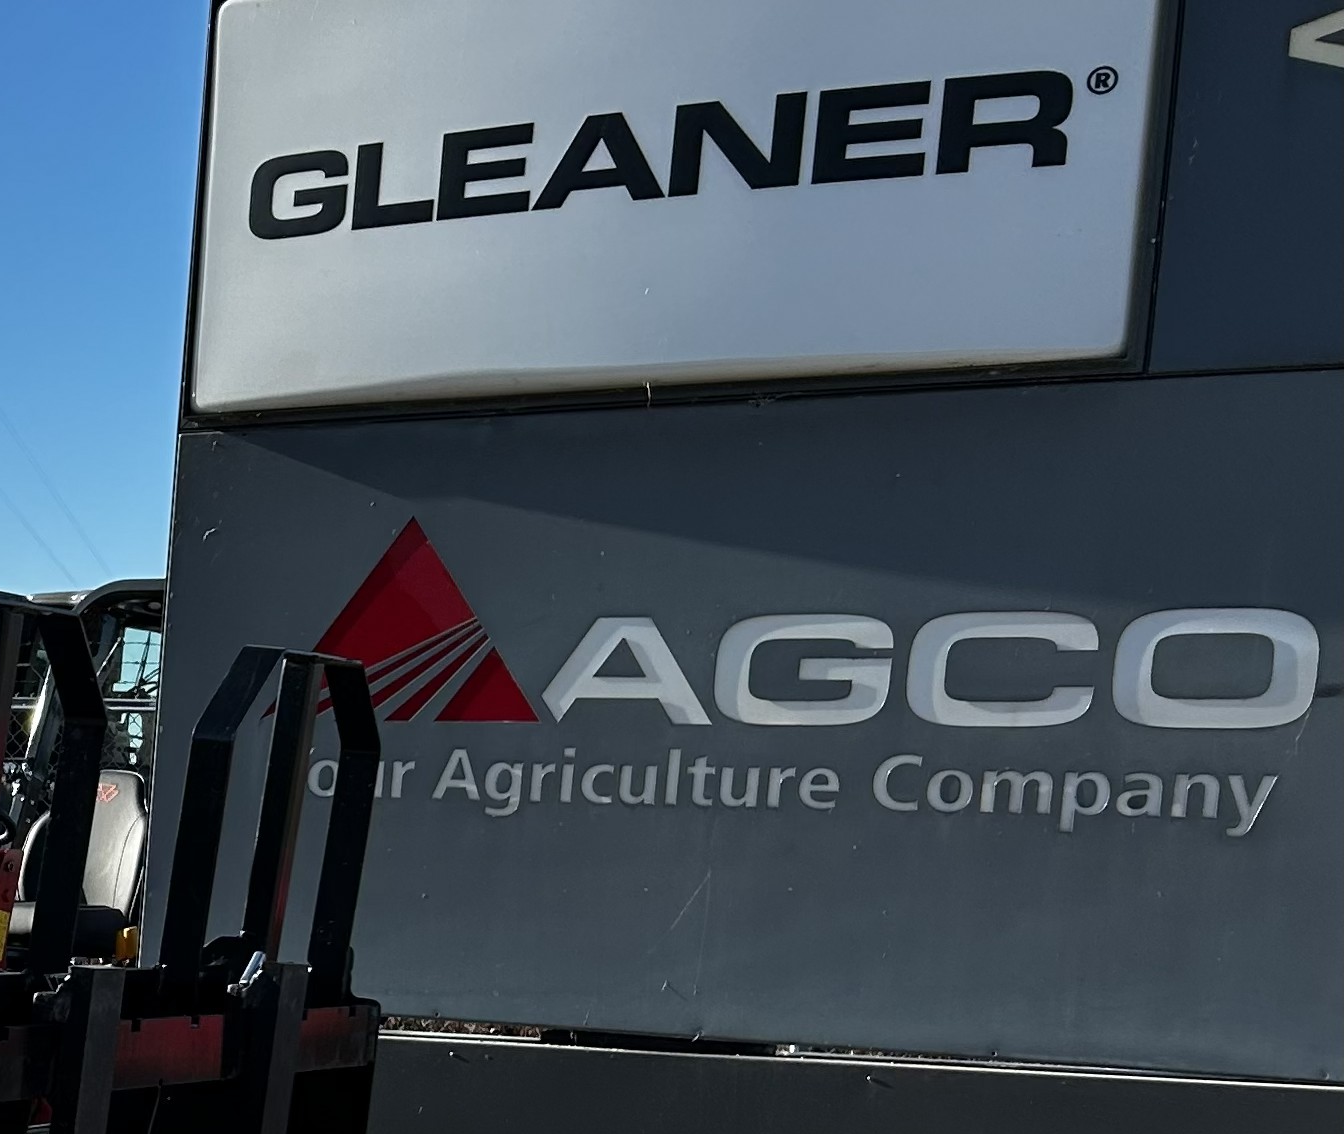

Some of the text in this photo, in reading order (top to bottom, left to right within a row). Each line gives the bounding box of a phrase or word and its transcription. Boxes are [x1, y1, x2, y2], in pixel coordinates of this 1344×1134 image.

[539, 607, 1320, 729] AGCO
[431, 747, 840, 818] Agriculture
[872, 754, 1279, 837] Company
